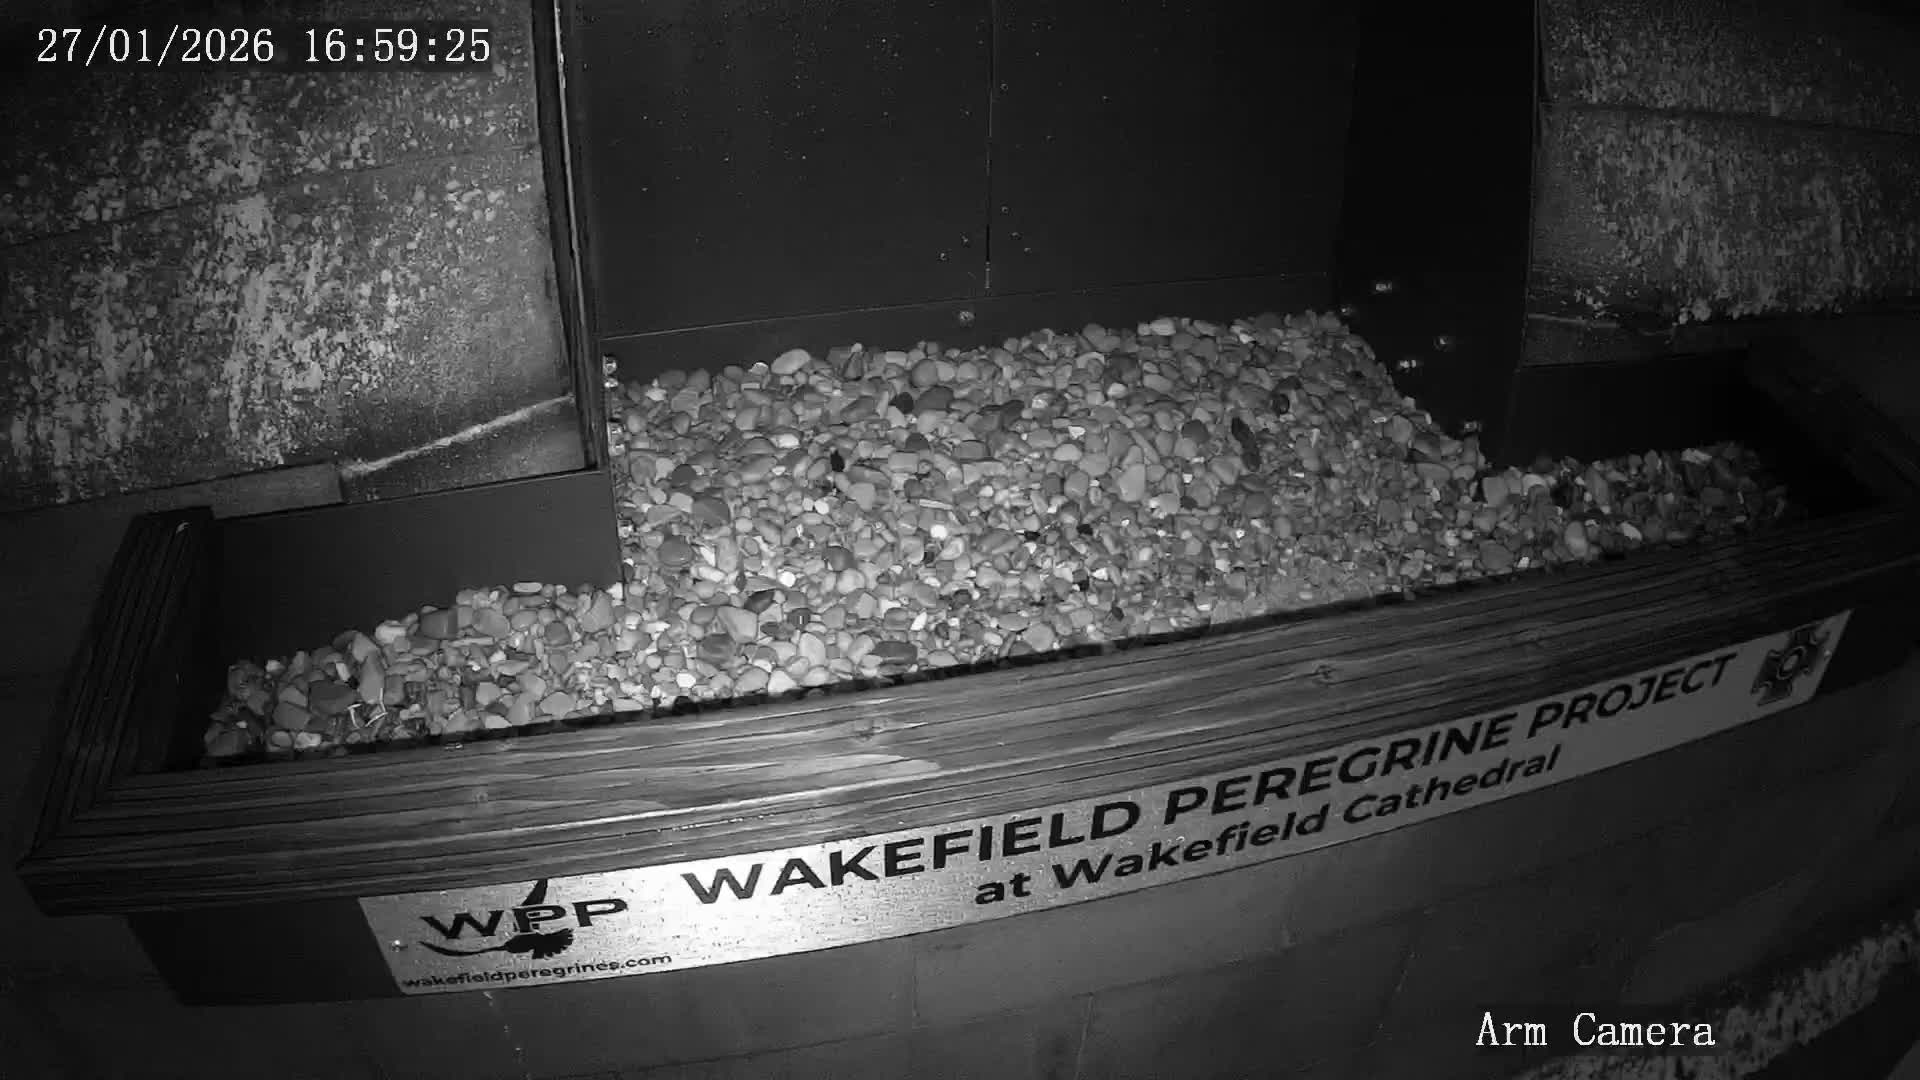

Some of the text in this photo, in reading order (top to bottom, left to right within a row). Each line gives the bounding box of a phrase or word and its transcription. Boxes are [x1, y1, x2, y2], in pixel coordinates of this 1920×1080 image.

[682, 653, 1737, 904] WAKEFIELD PEREGRINE PROJECT
[975, 744, 1562, 905] at Wakefield Cathedral
[419, 898, 628, 940] WPP
[402, 953, 673, 988] wakefieldperegrines.com
